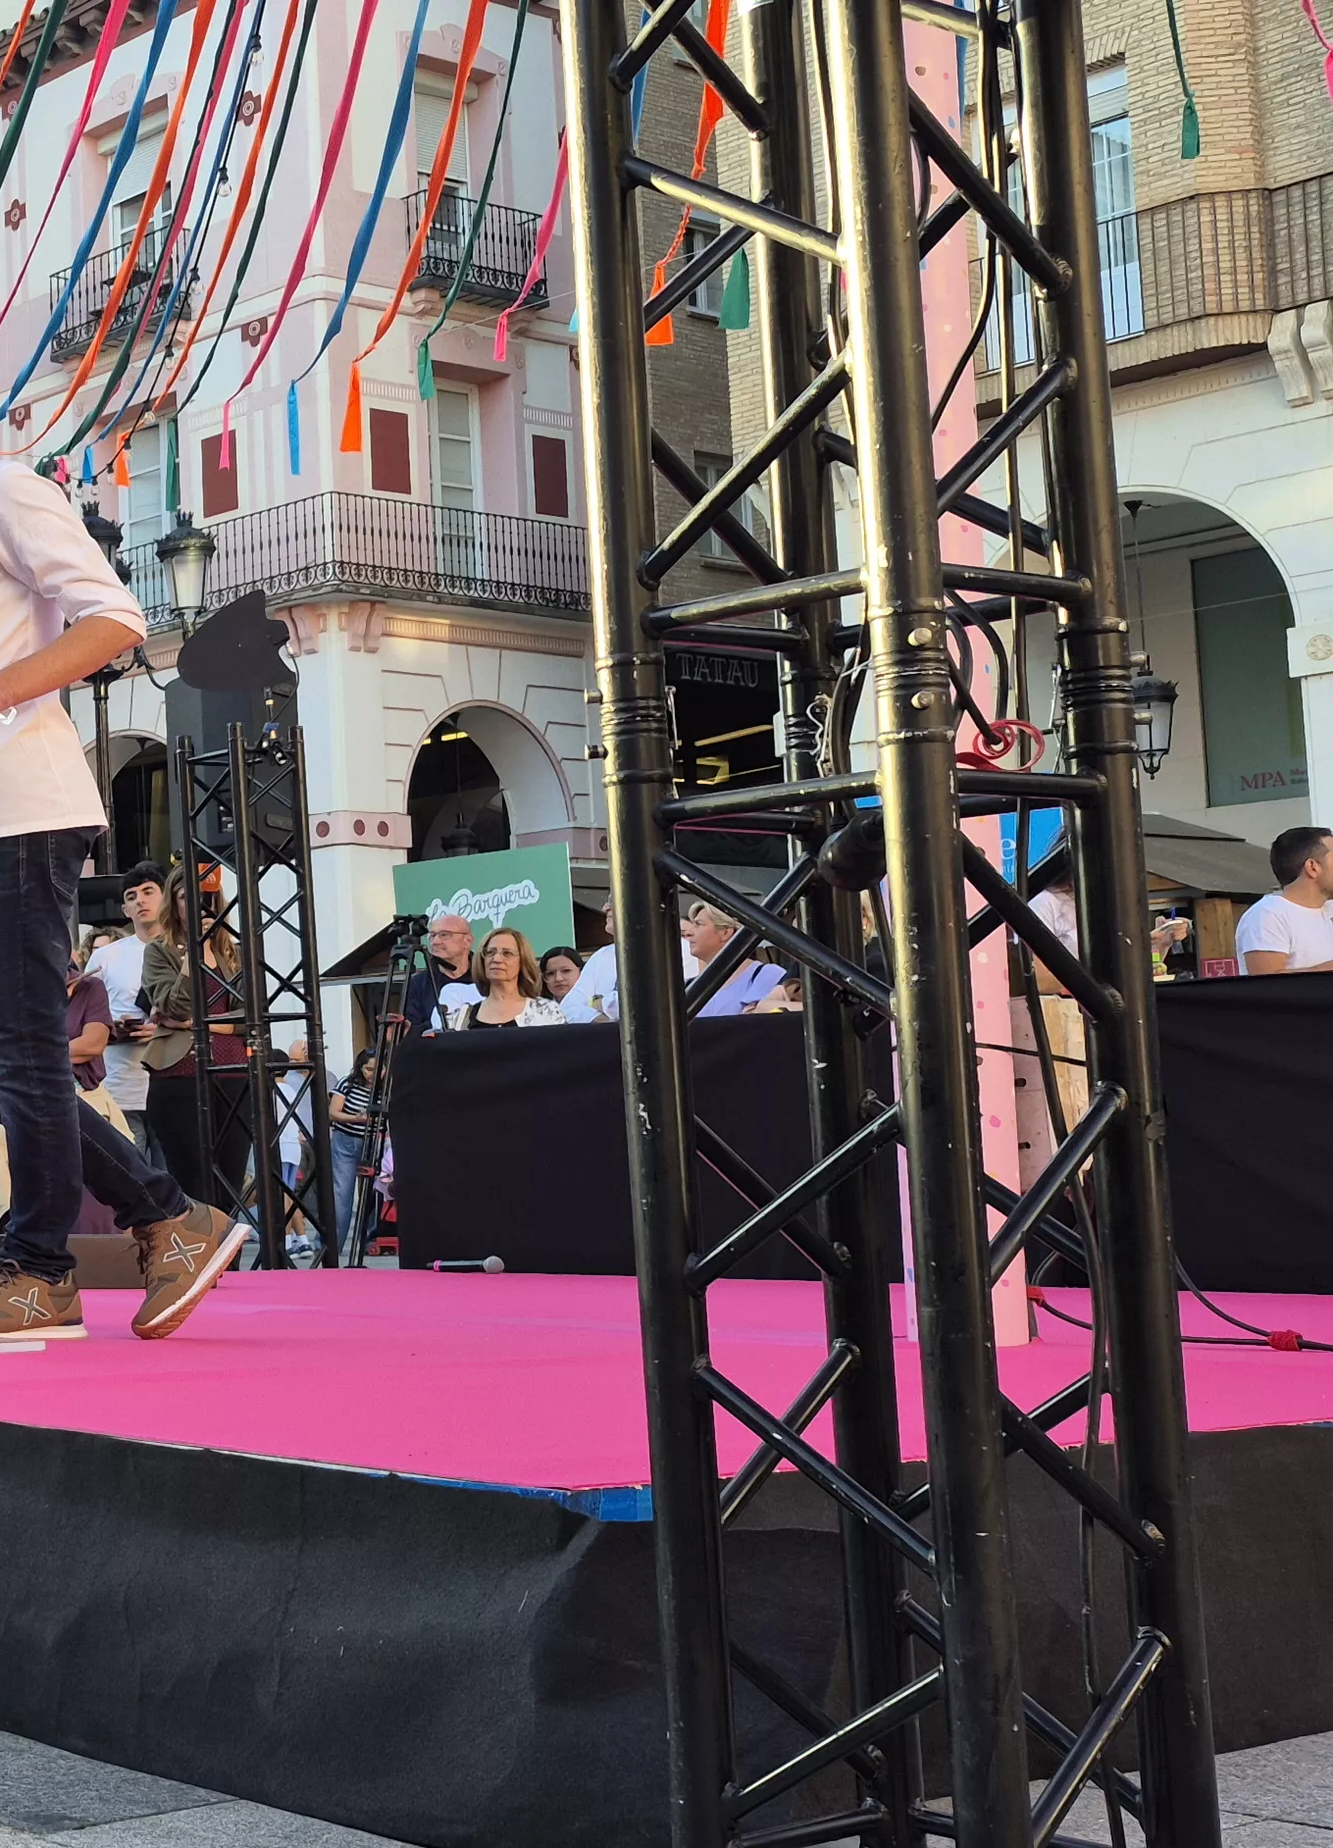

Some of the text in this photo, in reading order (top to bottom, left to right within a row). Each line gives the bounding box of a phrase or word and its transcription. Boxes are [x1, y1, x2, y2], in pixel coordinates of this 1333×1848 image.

[676, 652, 759, 687] TATAU
[1239, 769, 1287, 791] MPA
[452, 884, 535, 923] Barquera
